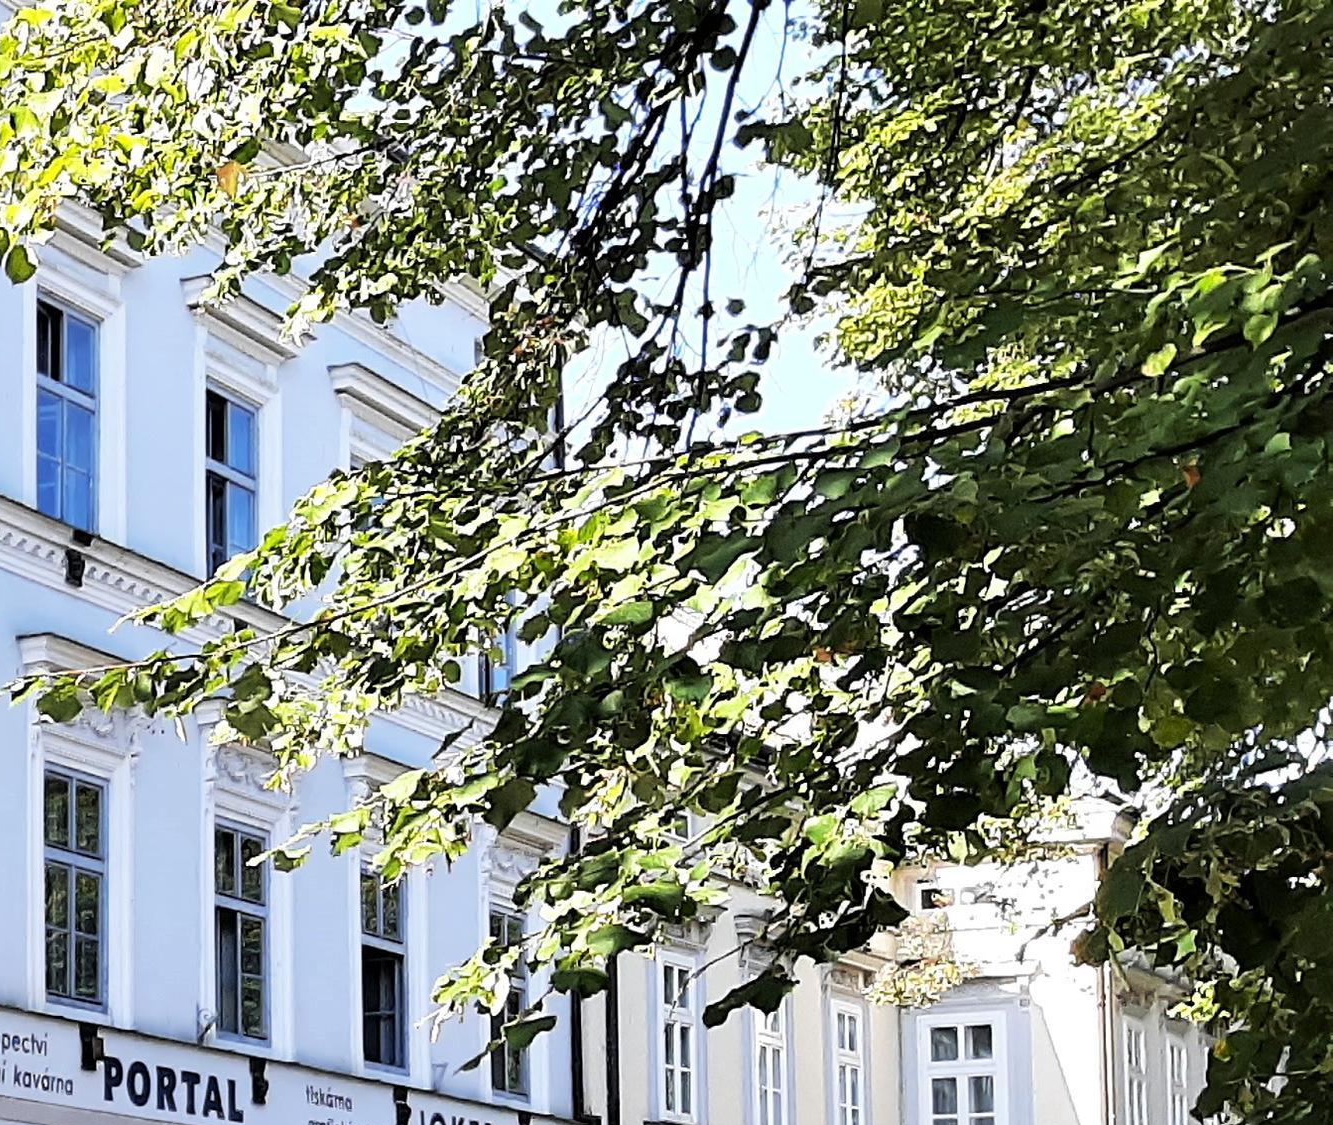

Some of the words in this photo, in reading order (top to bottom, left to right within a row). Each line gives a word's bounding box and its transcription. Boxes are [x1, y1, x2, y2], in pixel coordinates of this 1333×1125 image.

[13, 1065, 74, 1096] kavárna
[103, 1056, 244, 1123] PORTAL
[305, 1085, 353, 1112] tiskárna
